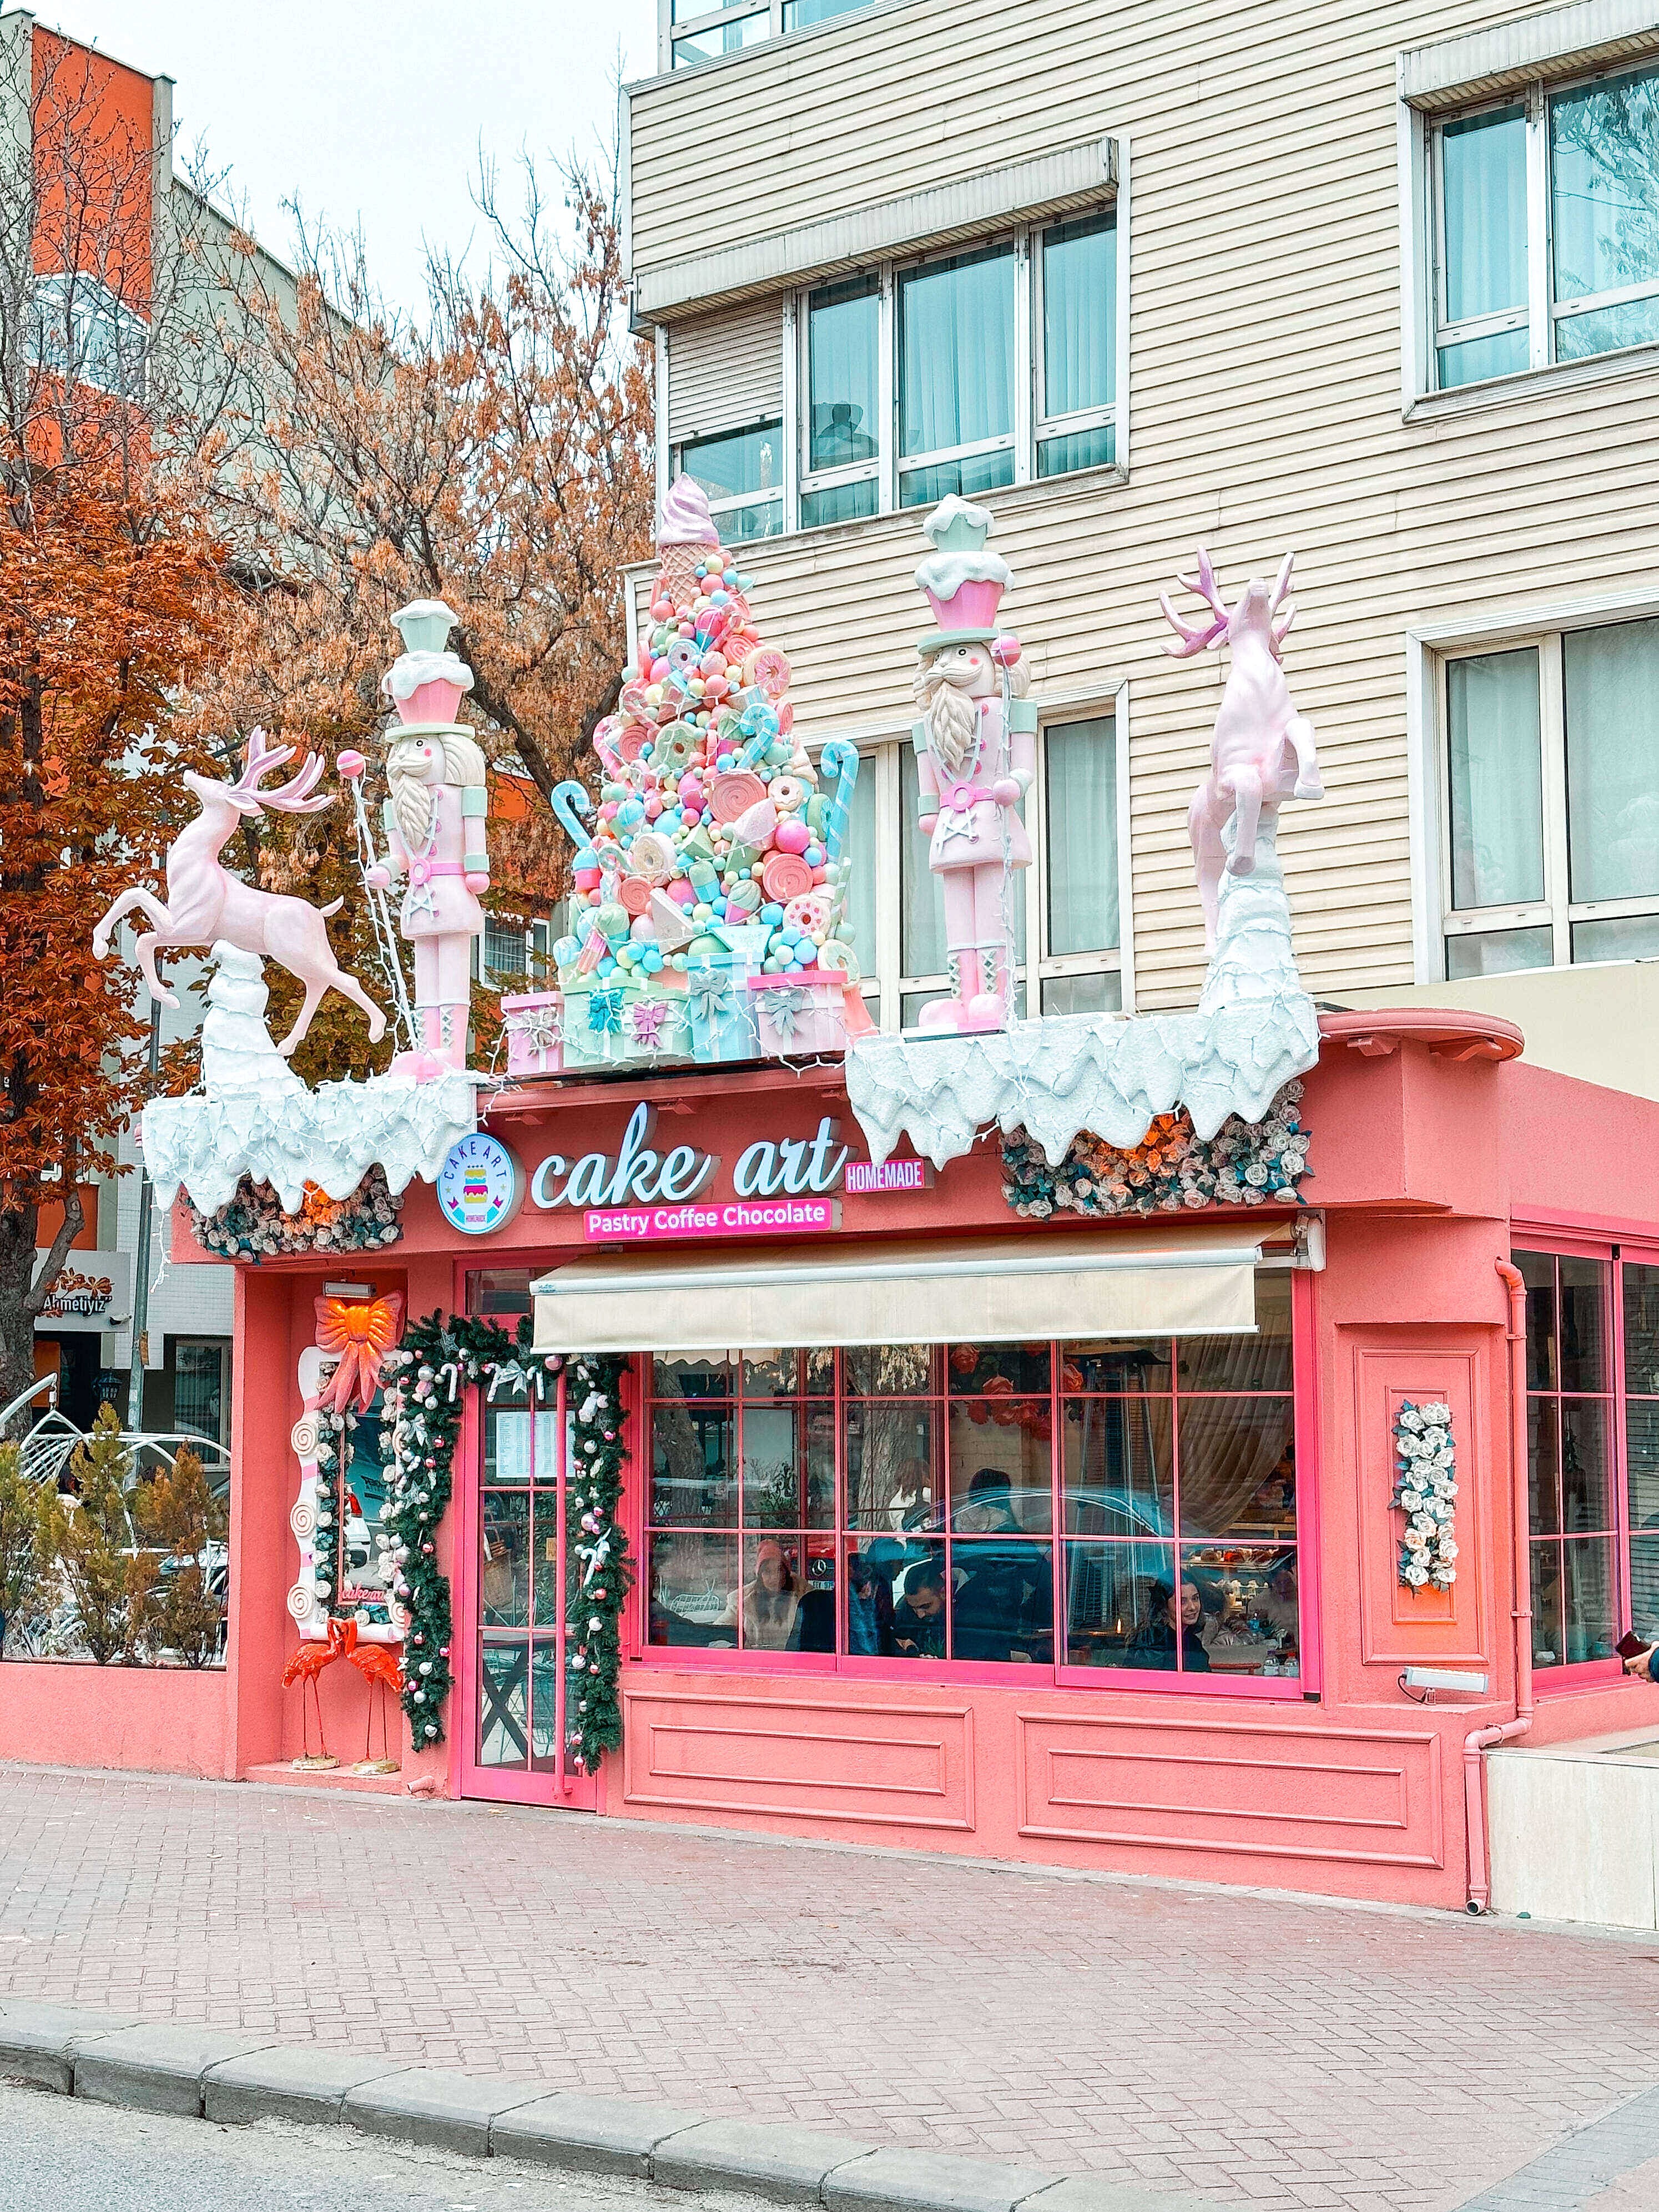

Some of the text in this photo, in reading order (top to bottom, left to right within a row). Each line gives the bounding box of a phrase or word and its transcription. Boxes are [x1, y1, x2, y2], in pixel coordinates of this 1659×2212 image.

[531, 1102, 848, 1209] cake art
[847, 1161, 922, 1191] HOMEMADE
[589, 1203, 826, 1235] Pastry Coffee Chocolate
